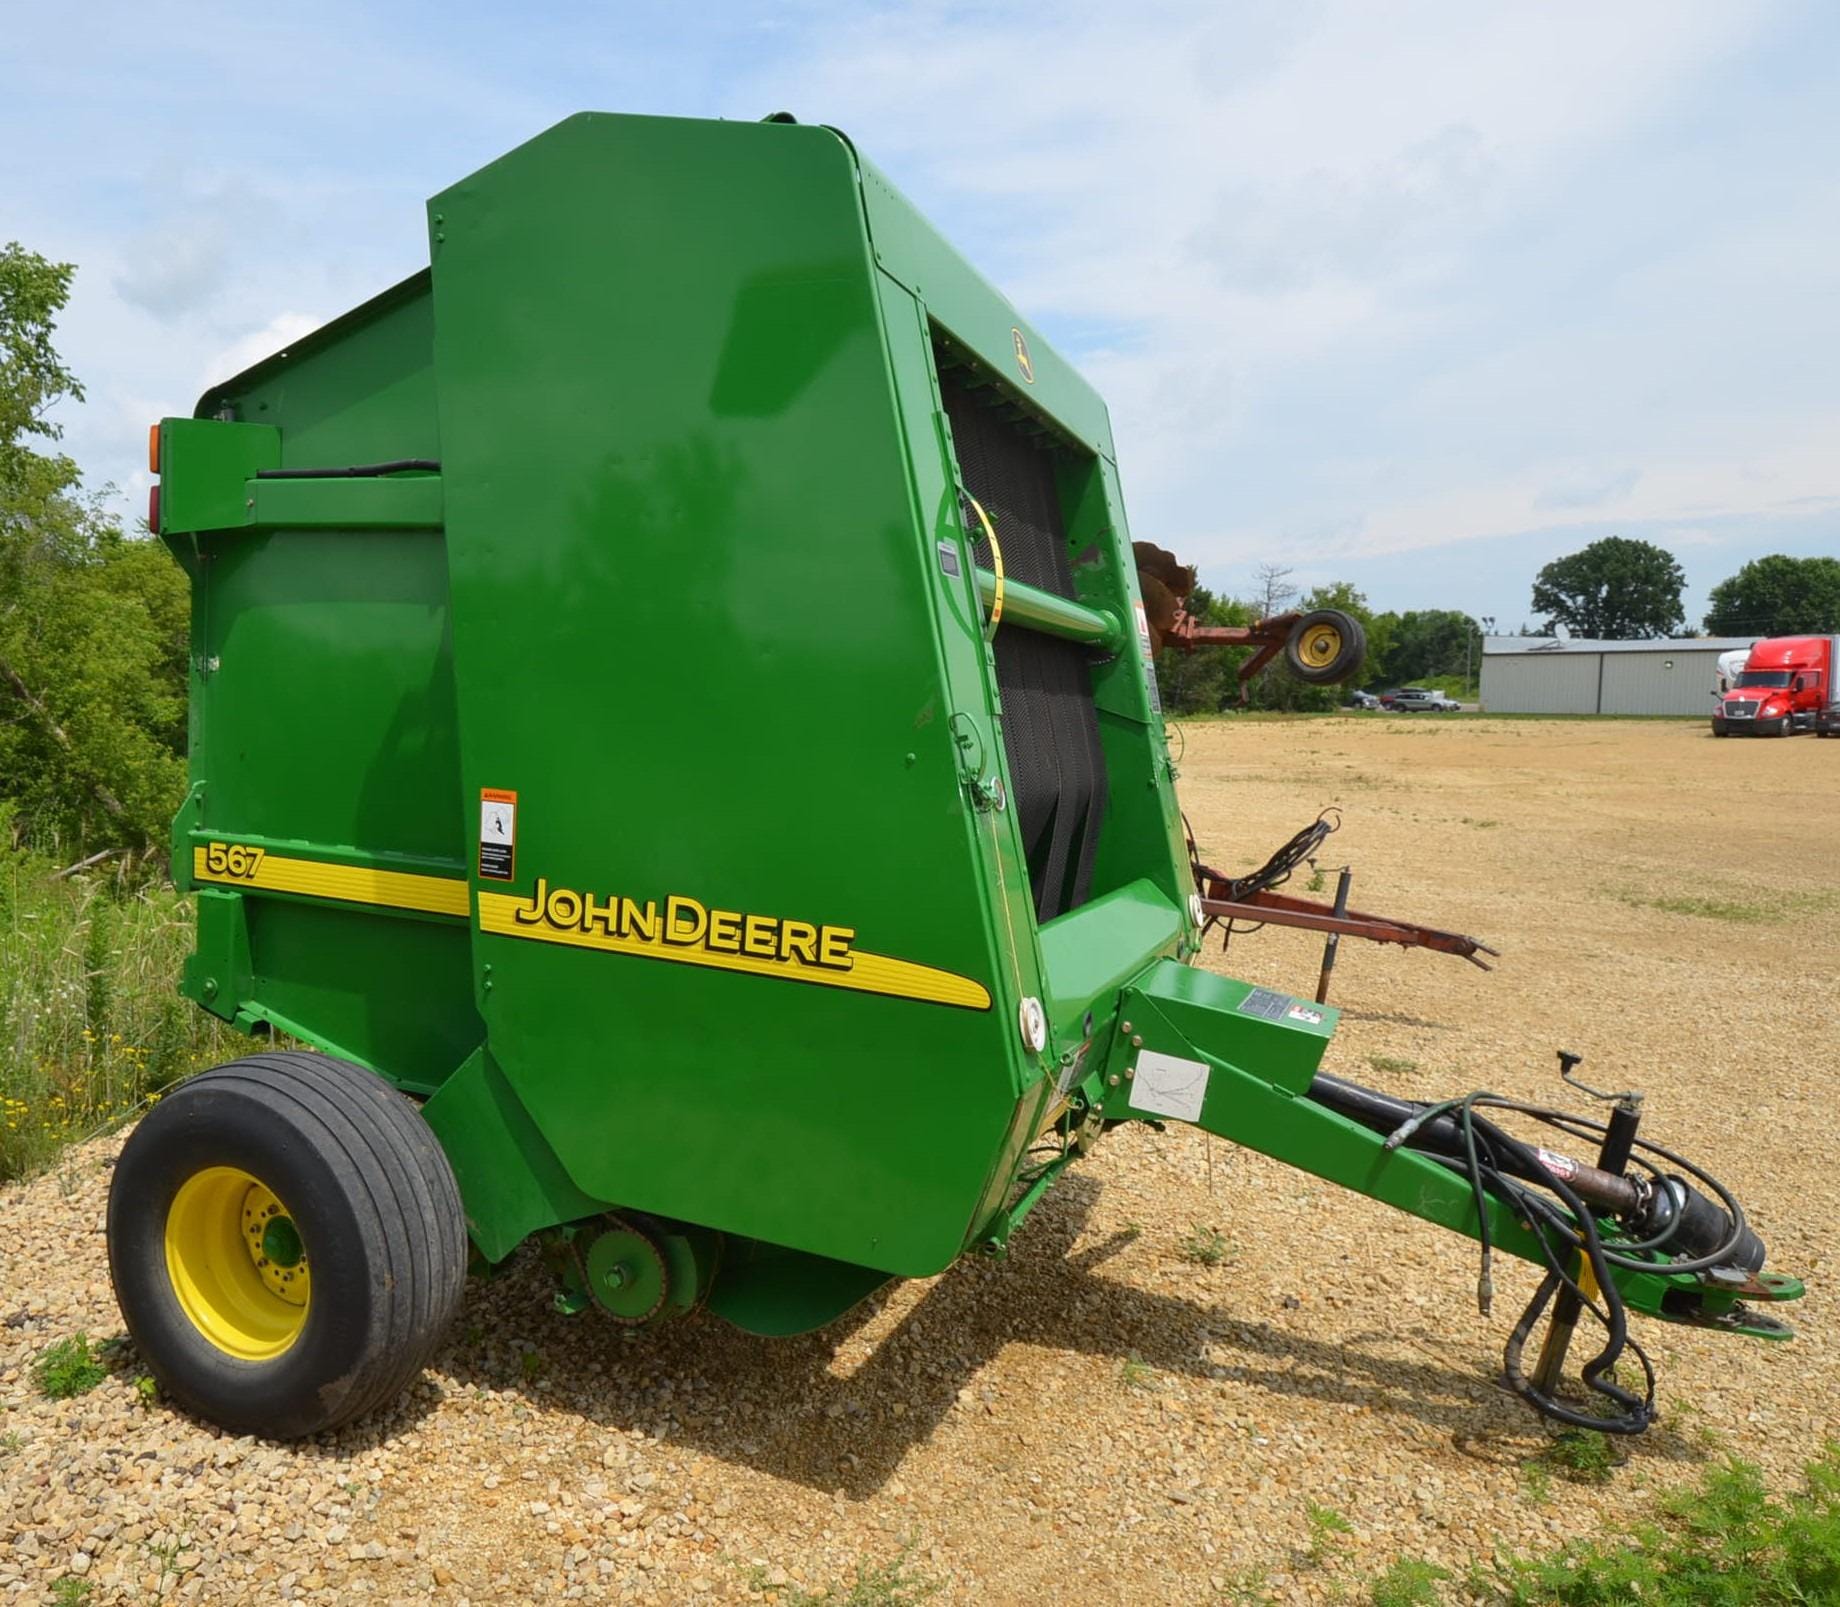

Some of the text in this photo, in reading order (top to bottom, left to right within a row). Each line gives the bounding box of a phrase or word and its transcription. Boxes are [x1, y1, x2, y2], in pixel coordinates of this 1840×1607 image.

[207, 842, 265, 878] 567
[517, 878, 854, 970] JOHN DEERE
